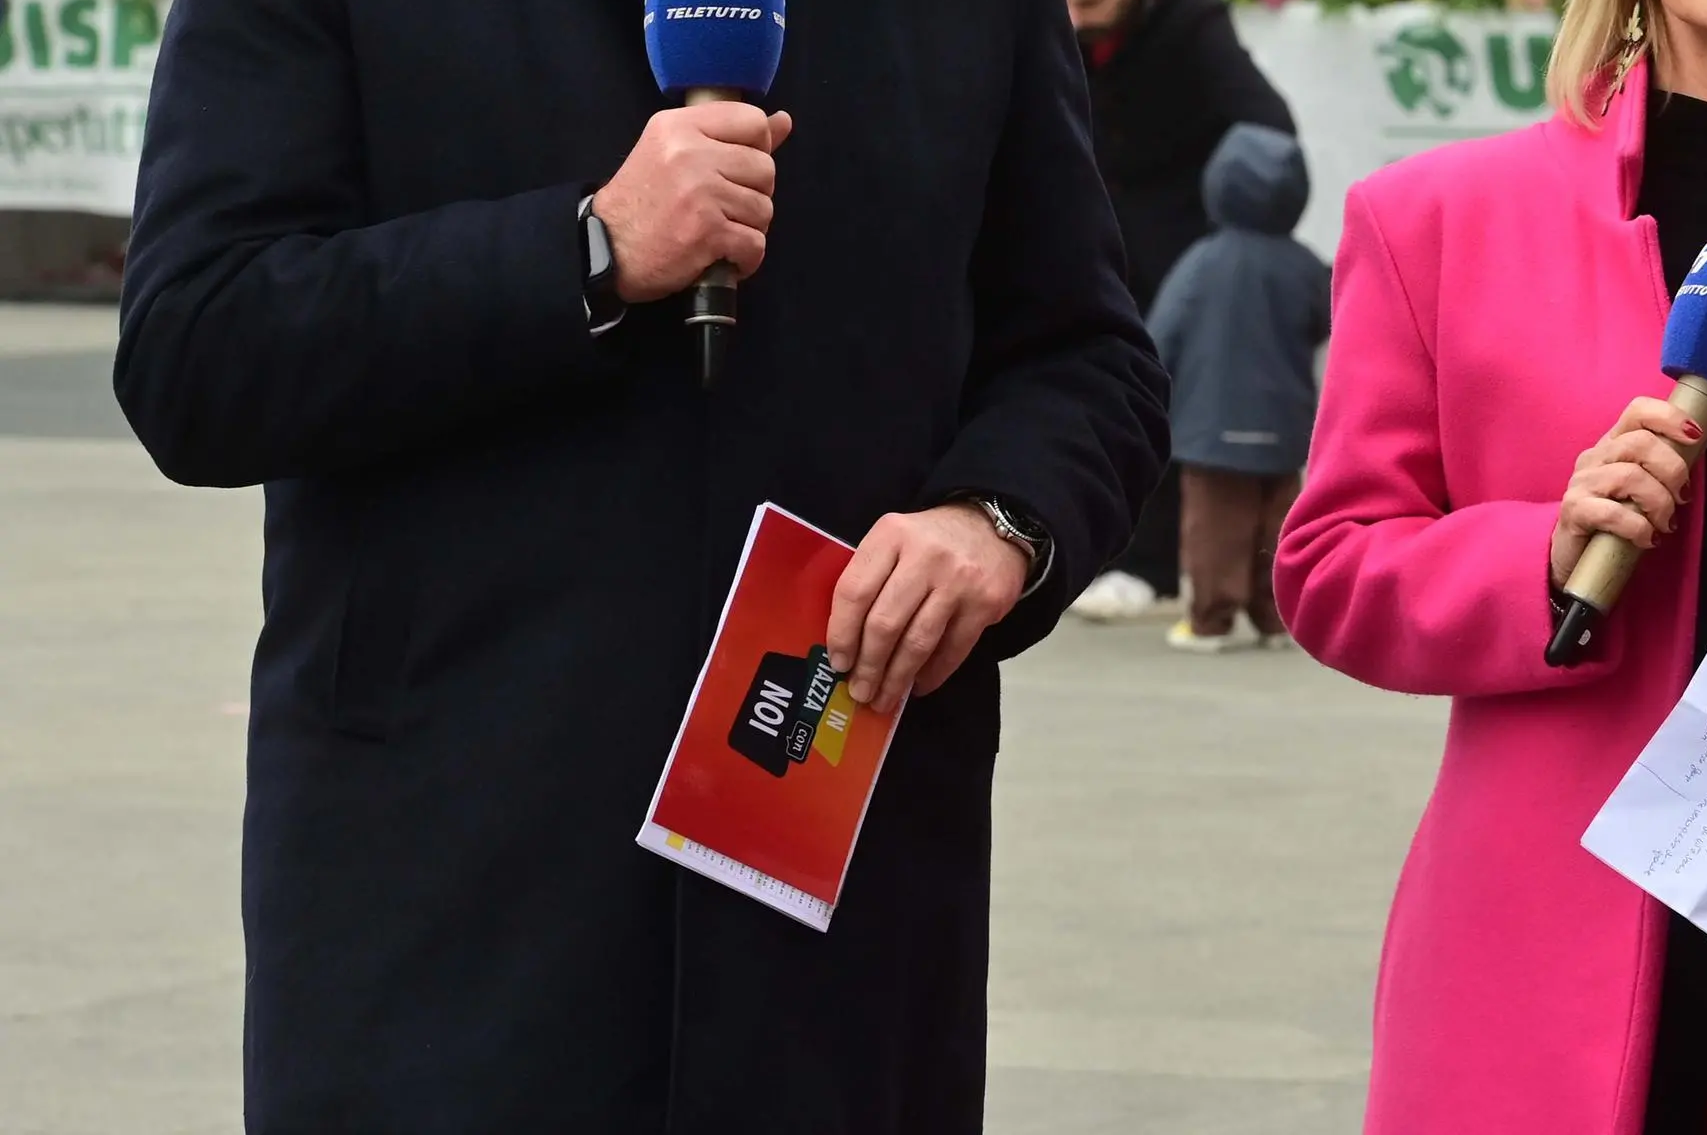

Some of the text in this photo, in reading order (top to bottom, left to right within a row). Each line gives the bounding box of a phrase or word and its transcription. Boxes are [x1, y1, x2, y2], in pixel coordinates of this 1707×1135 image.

[666, 6, 763, 21] TELETUTTO
[749, 679, 793, 737] NOI
[792, 652, 837, 752] IAZZA con
[826, 709, 849, 732] IN
